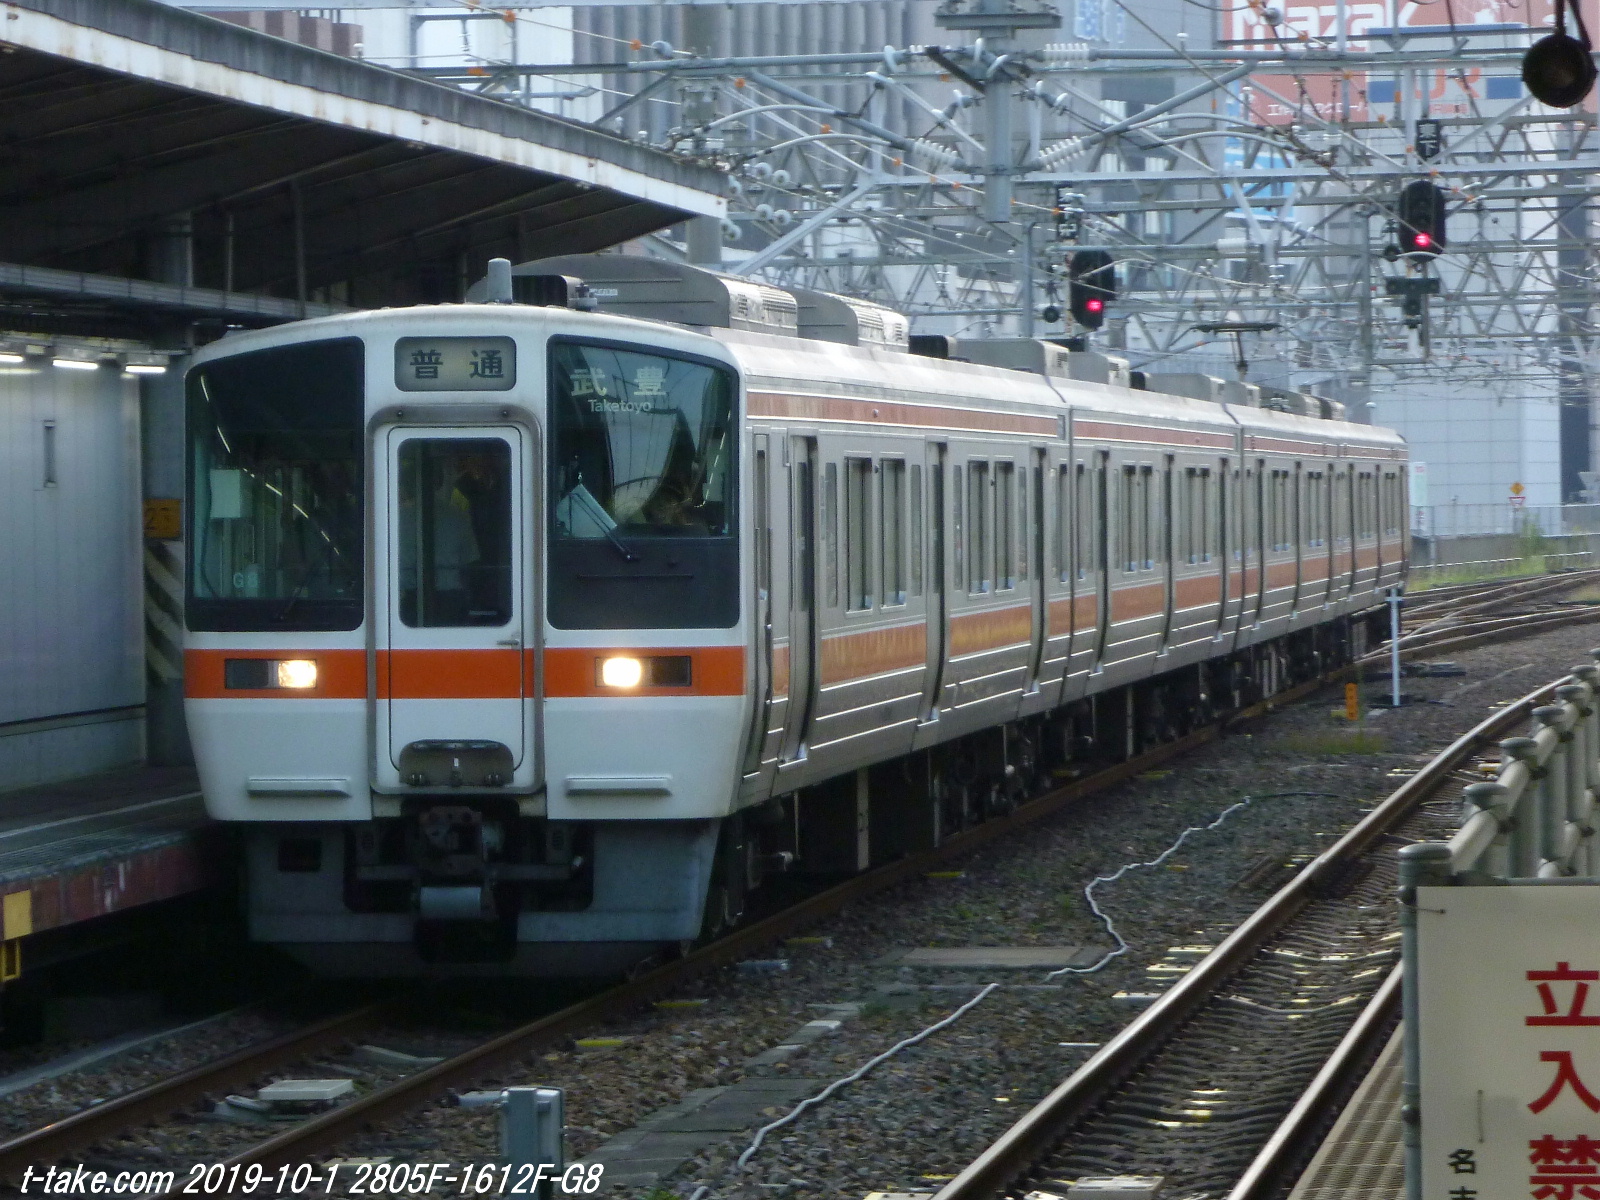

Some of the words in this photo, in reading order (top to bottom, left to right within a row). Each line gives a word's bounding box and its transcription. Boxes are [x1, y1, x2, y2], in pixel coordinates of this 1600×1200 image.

[409, 349, 504, 380] 普通
[570, 366, 666, 397] 武豊
[588, 399, 651, 414] Taketoyo
